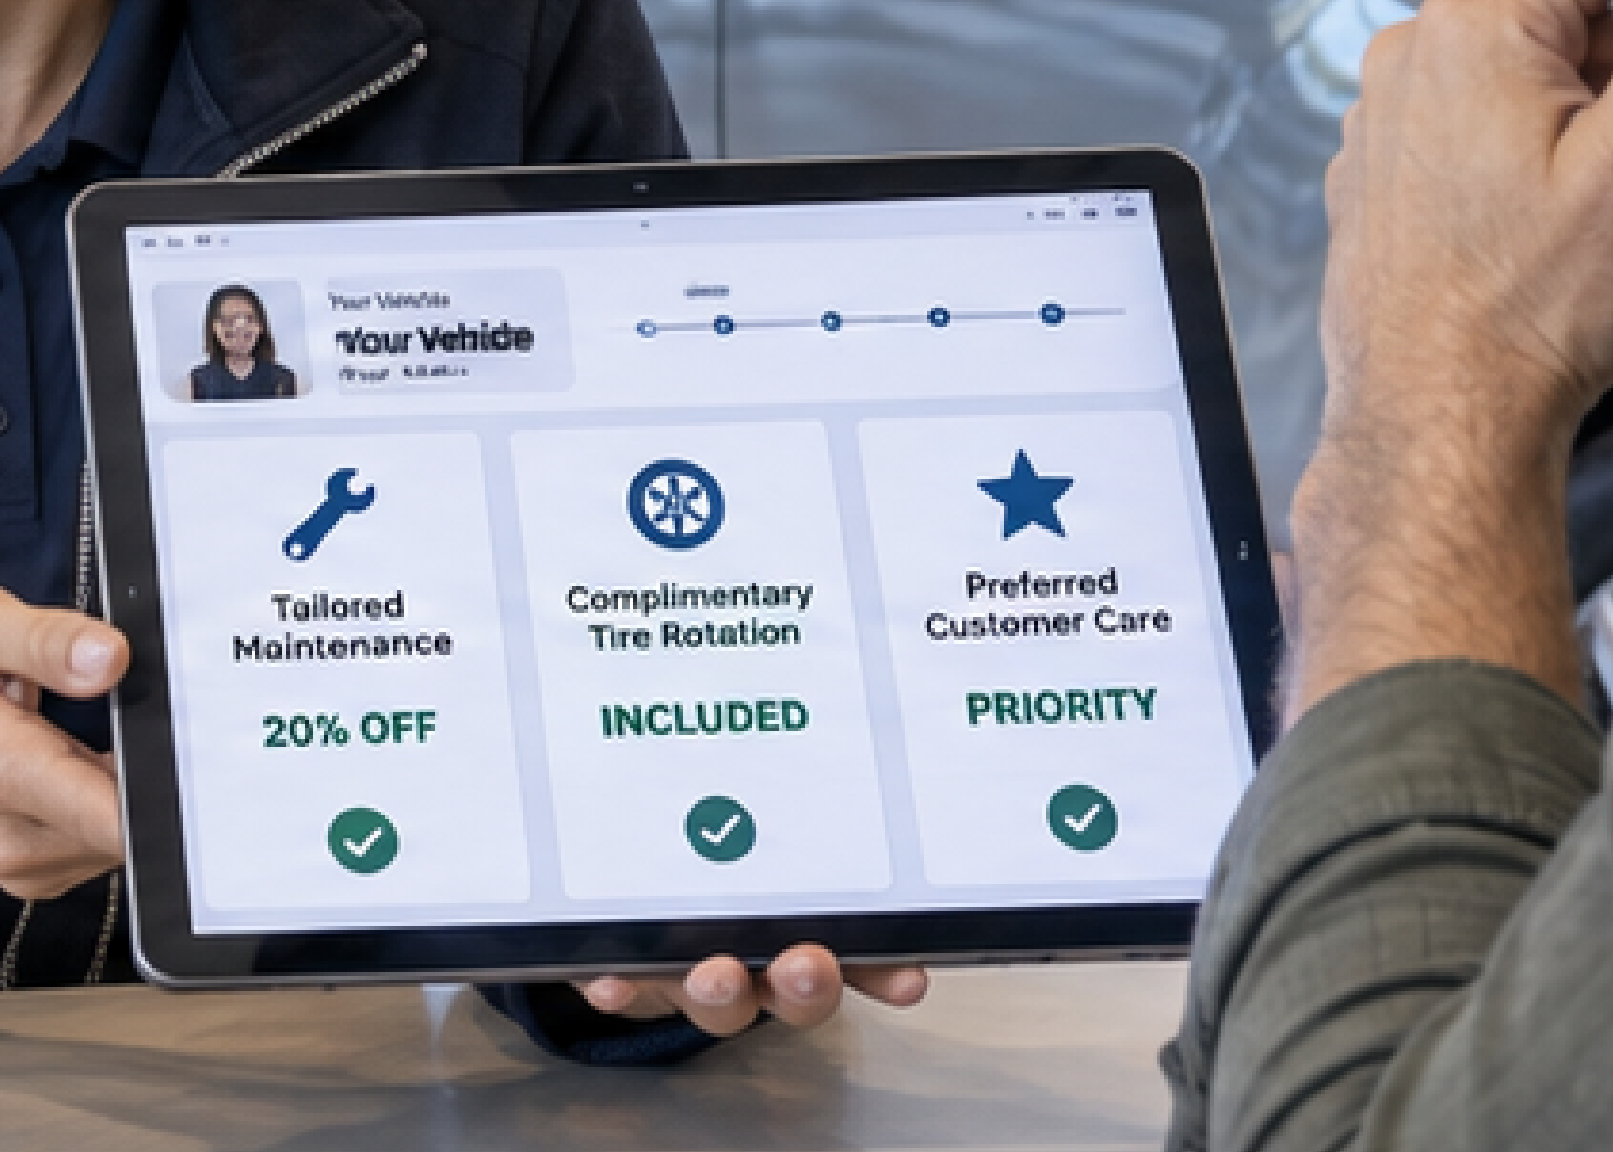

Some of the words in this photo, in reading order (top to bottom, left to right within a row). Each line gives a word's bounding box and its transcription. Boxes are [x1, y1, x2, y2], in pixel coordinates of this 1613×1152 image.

[567, 582, 814, 616] Complimentary
[966, 567, 1119, 600] Preferred
[271, 590, 405, 622] Tailored
[926, 610, 1084, 640] Customer
[1094, 605, 1172, 633] Care
[233, 630, 453, 662] Maintenance
[588, 623, 651, 651] Tire
[663, 617, 800, 648] Rotation
[601, 699, 809, 738] INCLUDED
[965, 687, 1157, 726] PRIORITY
[262, 712, 350, 748] 20%
[361, 710, 436, 744] OFF
